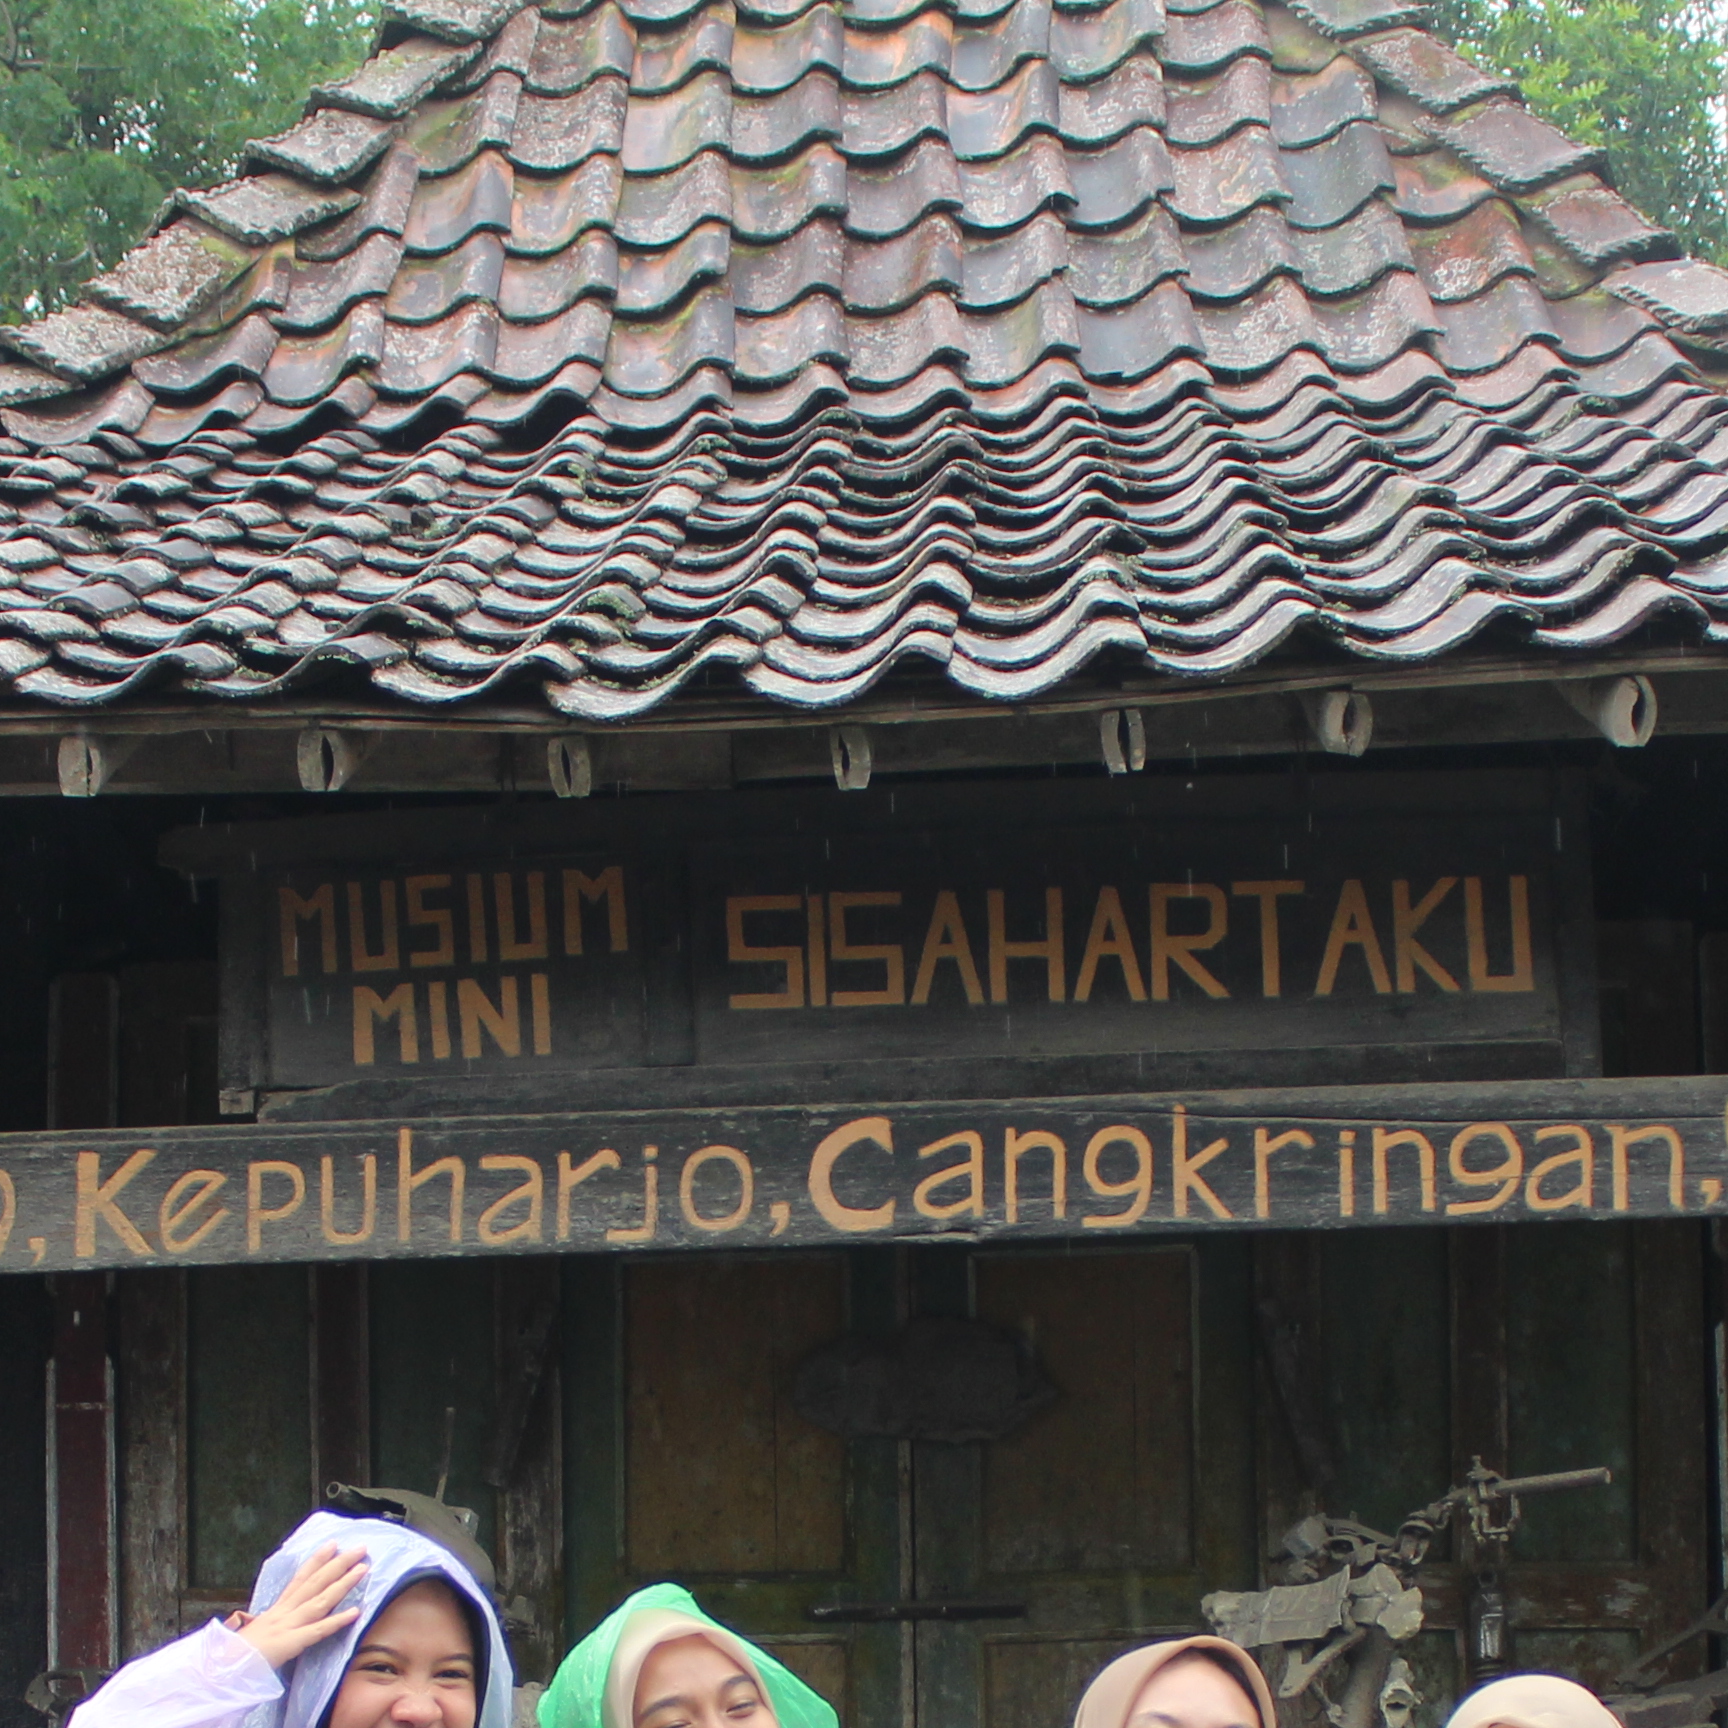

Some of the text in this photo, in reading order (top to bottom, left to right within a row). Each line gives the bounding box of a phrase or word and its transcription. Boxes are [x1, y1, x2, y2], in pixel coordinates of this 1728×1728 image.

[278, 866, 629, 977] MUSIUM
[726, 874, 1535, 1010] SISAHARTAKU
[352, 973, 553, 1066] MINI
[75, 1127, 790, 1257] Kepuharjo,
[807, 1104, 1720, 1232] Cangkringan,
